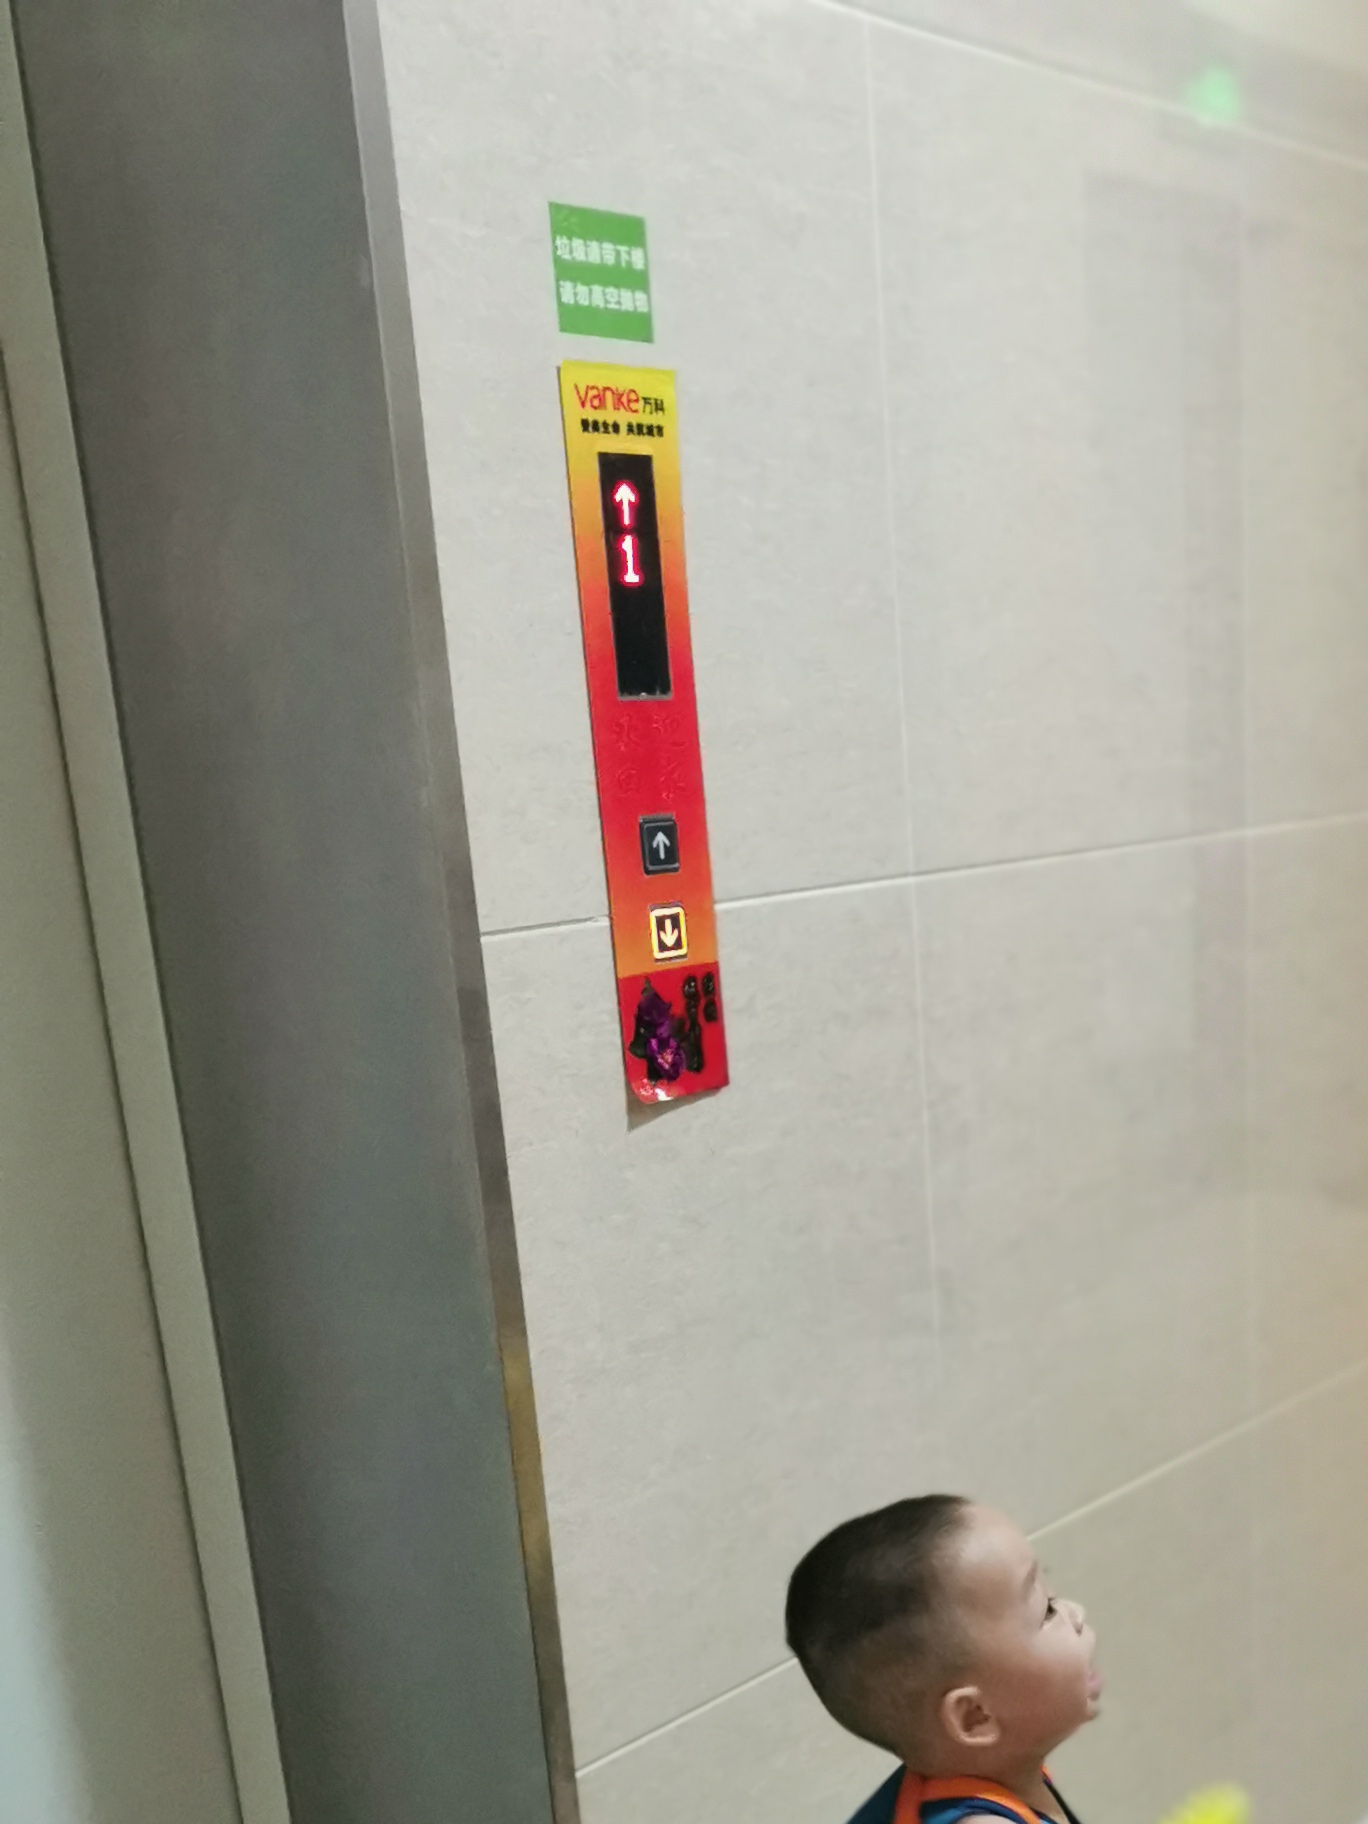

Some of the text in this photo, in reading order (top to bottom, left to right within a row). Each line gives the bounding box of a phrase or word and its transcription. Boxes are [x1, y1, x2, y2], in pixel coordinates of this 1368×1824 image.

[555, 234, 646, 270] 垃圾请带下楼
[641, 396, 665, 415] 万科
[619, 532, 644, 585] 1
